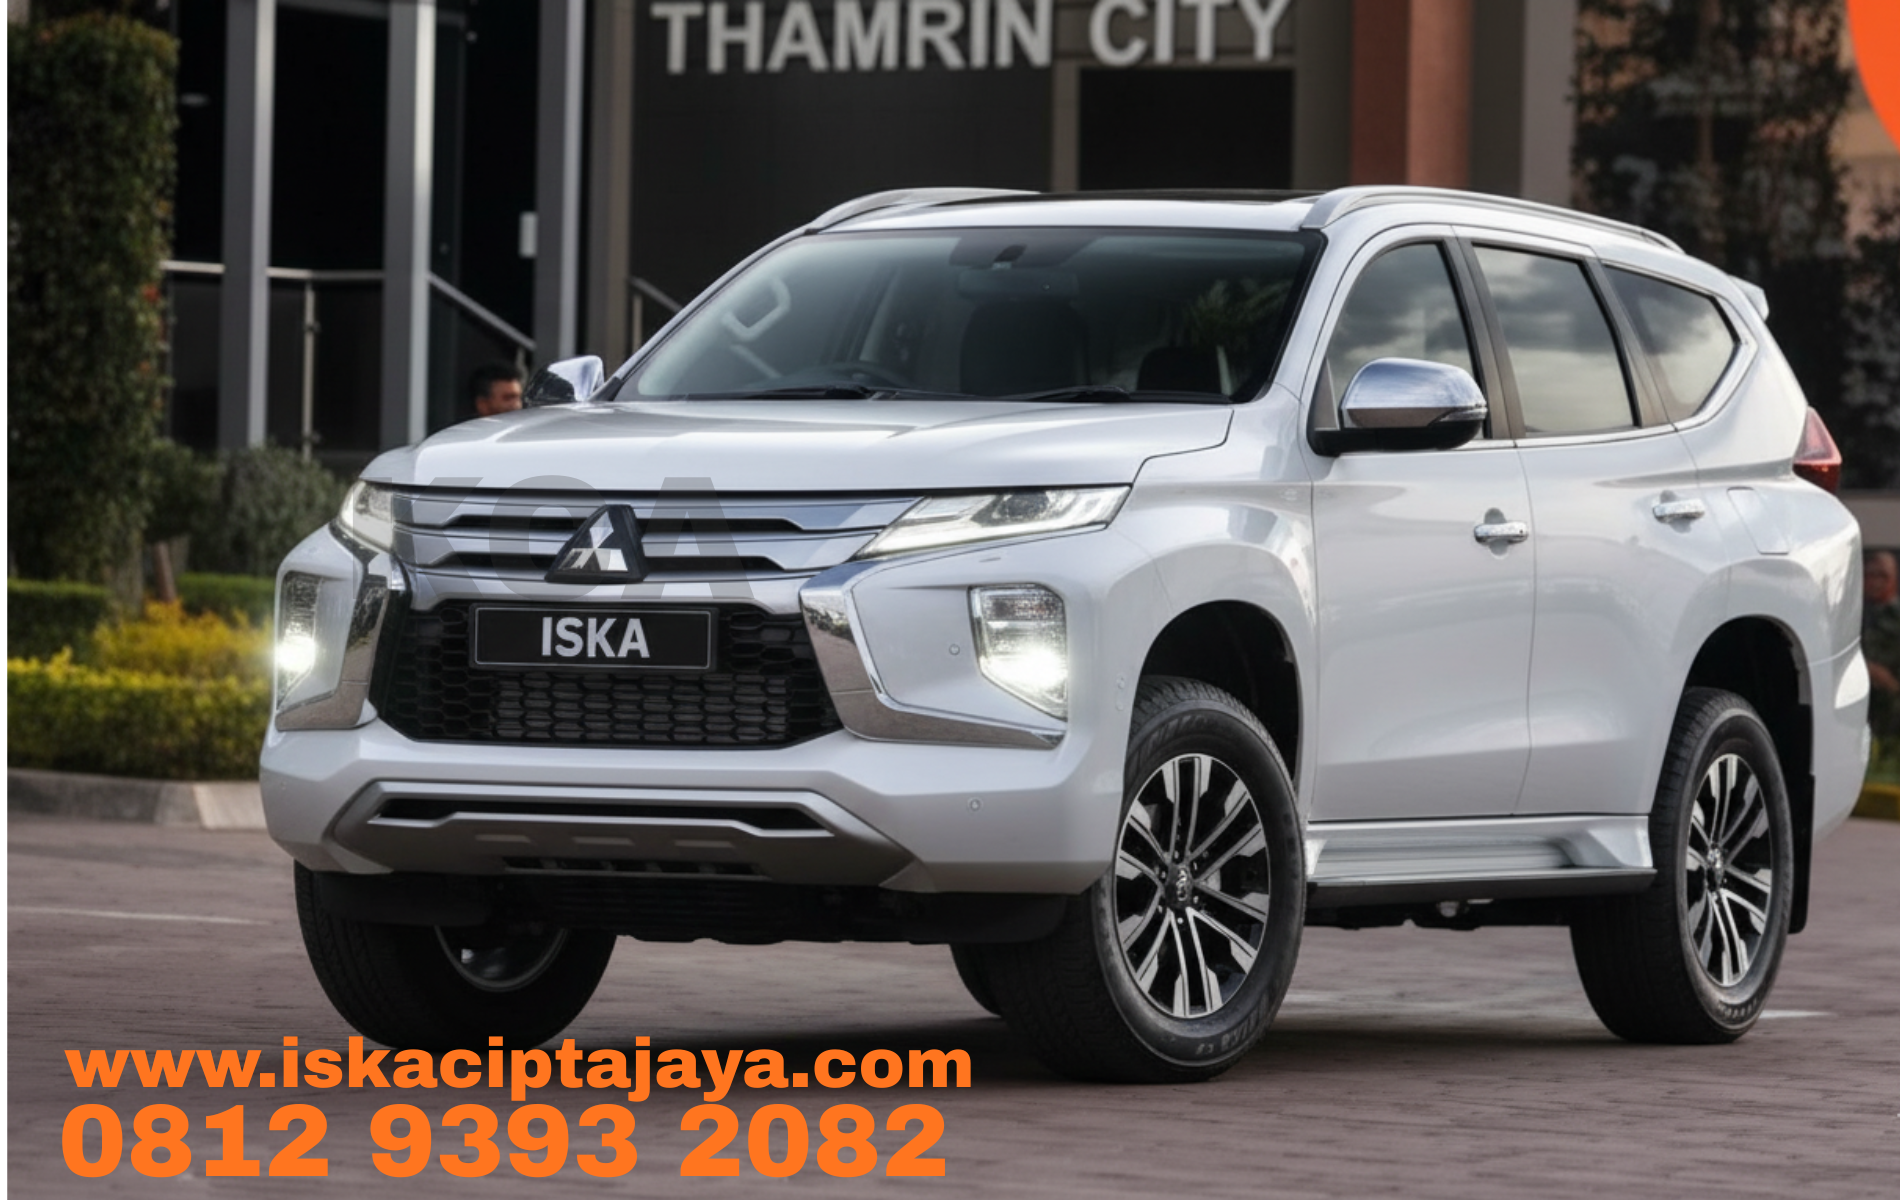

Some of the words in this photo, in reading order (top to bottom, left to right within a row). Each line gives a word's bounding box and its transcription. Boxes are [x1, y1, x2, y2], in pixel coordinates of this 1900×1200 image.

[651, 0, 1053, 74] THAMRIN
[1088, 0, 1291, 66] CITY
[541, 616, 650, 659] ISKA
